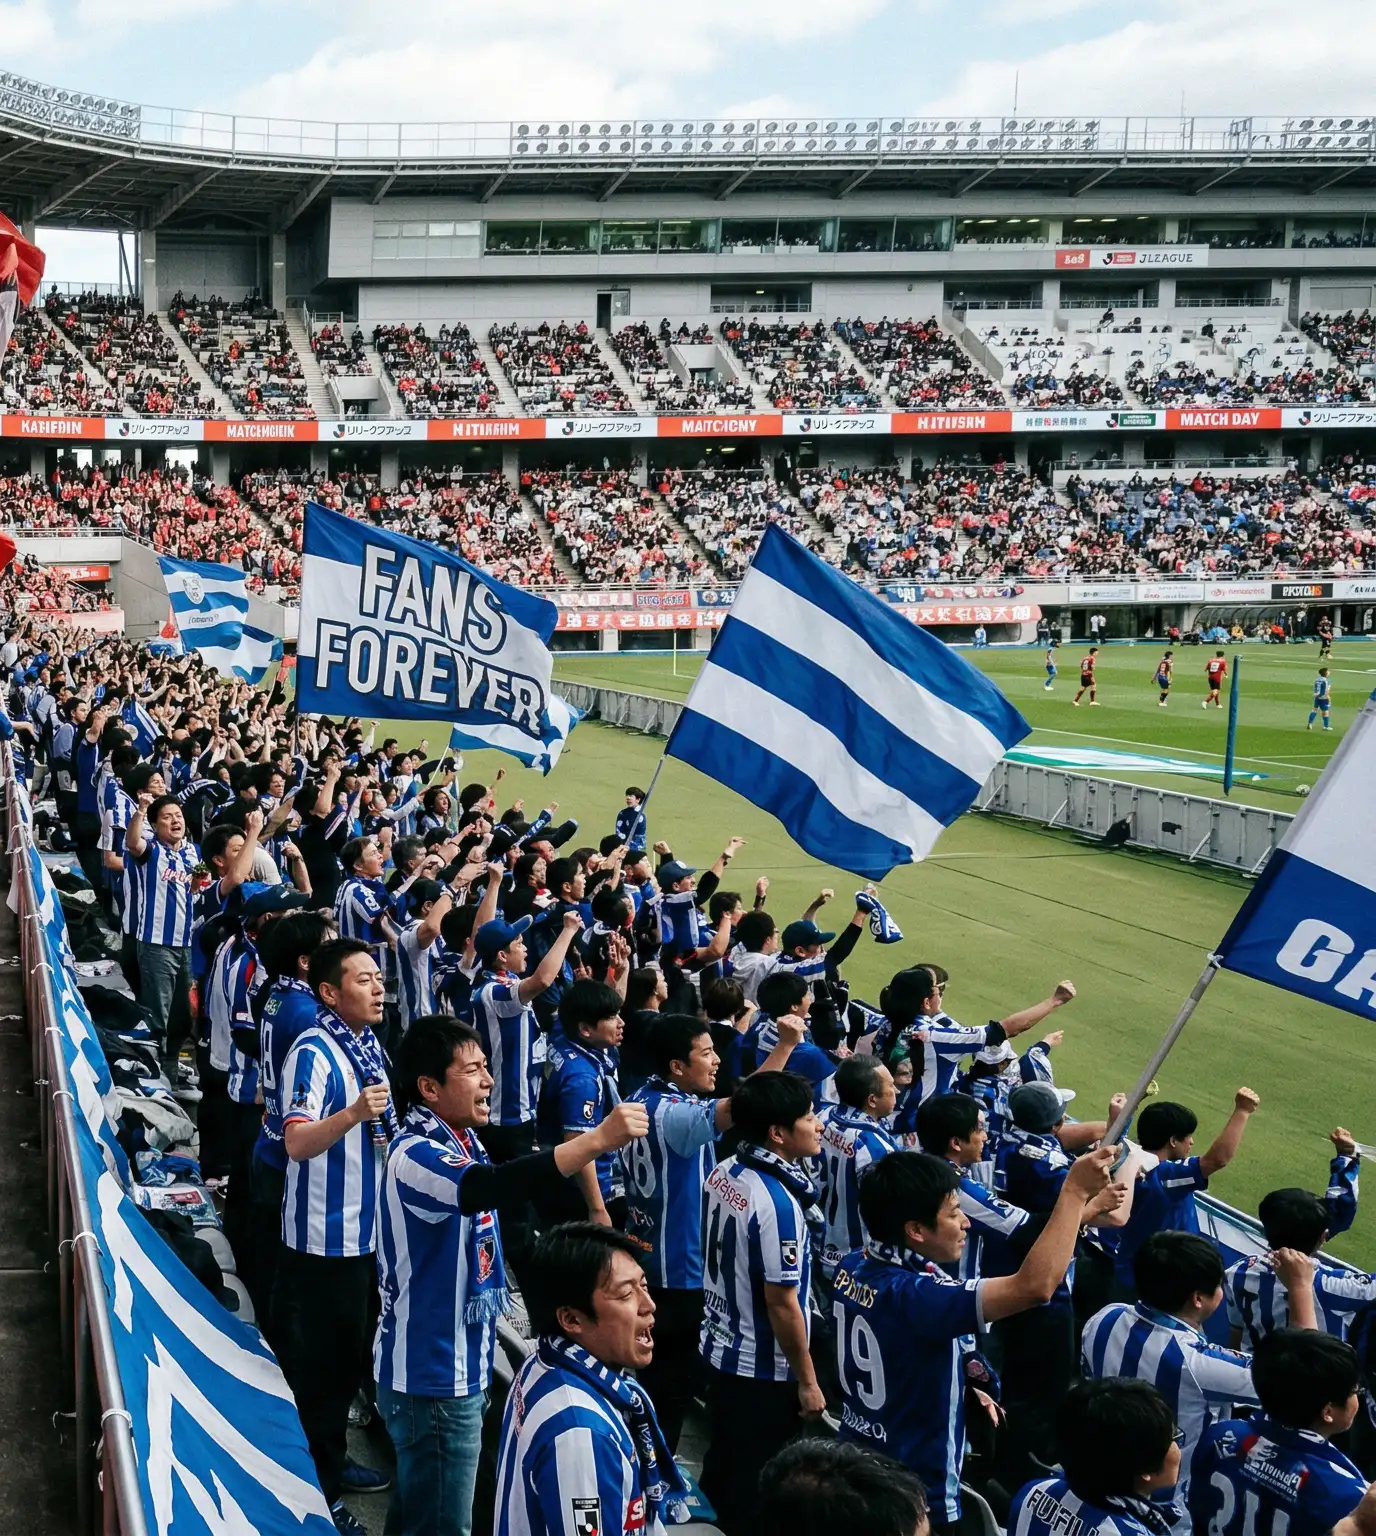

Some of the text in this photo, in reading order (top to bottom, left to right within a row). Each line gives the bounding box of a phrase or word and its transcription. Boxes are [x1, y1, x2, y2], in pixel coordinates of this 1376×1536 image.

[1180, 412, 1260, 426] MATCH DAY
[361, 543, 502, 653] FANS
[315, 621, 544, 736] FOREVER
[833, 1301, 887, 1410] 19
